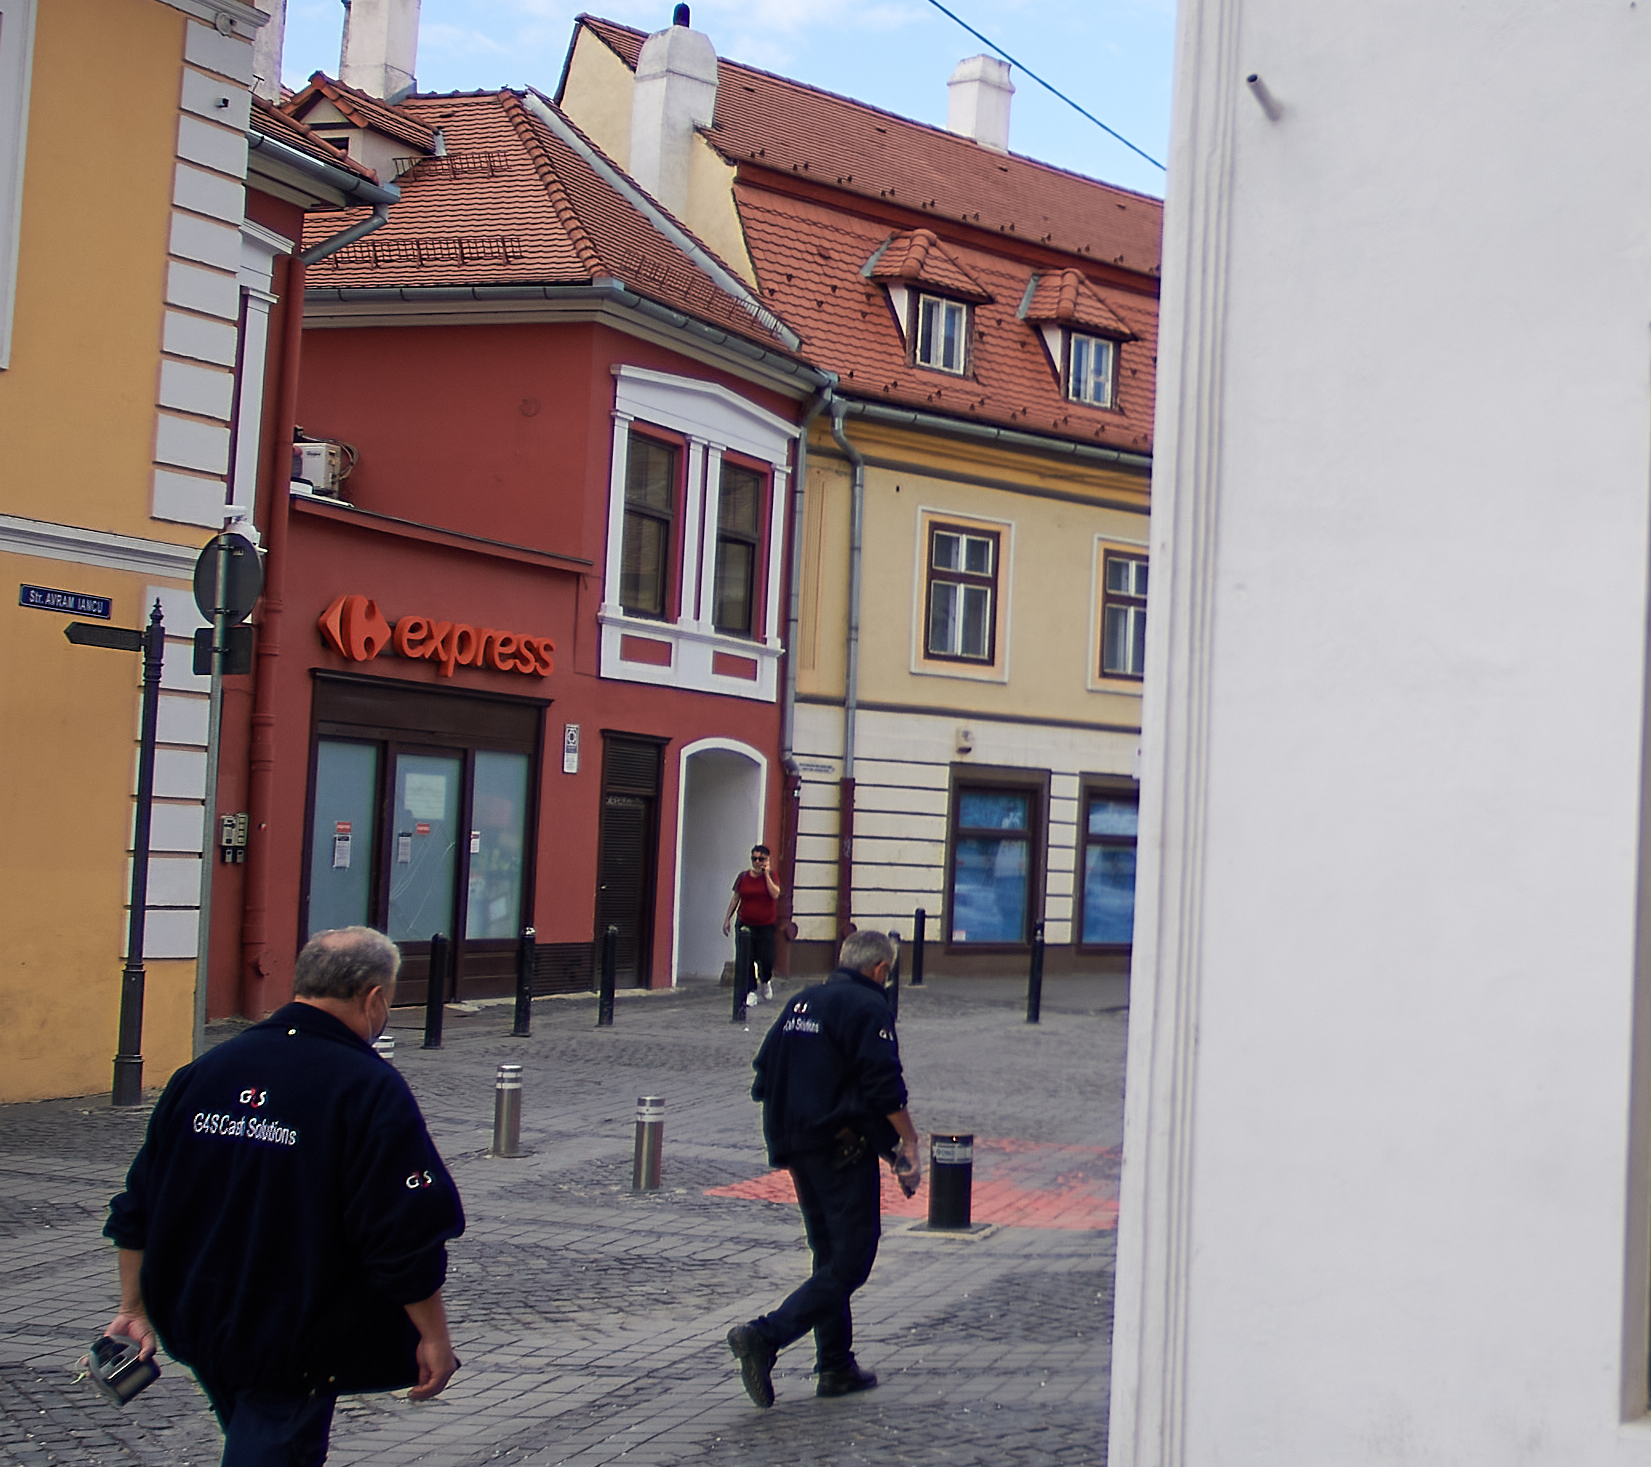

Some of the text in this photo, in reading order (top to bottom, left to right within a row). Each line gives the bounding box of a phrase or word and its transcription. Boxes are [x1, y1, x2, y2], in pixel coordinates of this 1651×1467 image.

[29, 590, 104, 613] Str. AVRAM IANCU
[394, 614, 557, 678] express
[246, 1117, 298, 1147] Solutions
